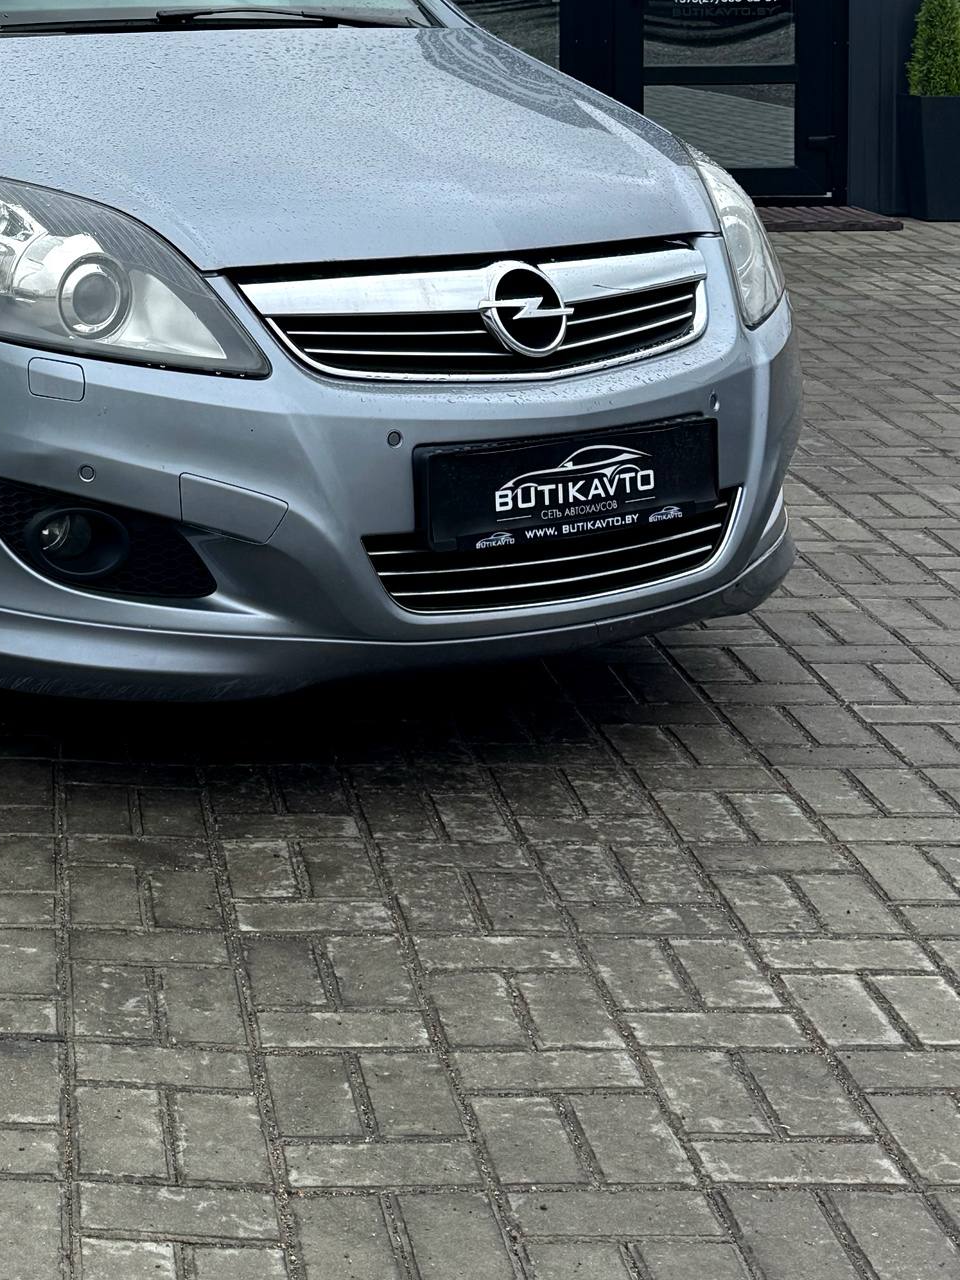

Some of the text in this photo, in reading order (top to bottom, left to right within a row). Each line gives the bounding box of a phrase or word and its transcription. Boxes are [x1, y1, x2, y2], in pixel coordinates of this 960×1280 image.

[495, 469, 655, 512] BUTIKAVTO
[541, 499, 618, 520] СЕТЬ АВТОХАУСОВ
[524, 513, 639, 539] WWW. BUTIKAVTO.BY
